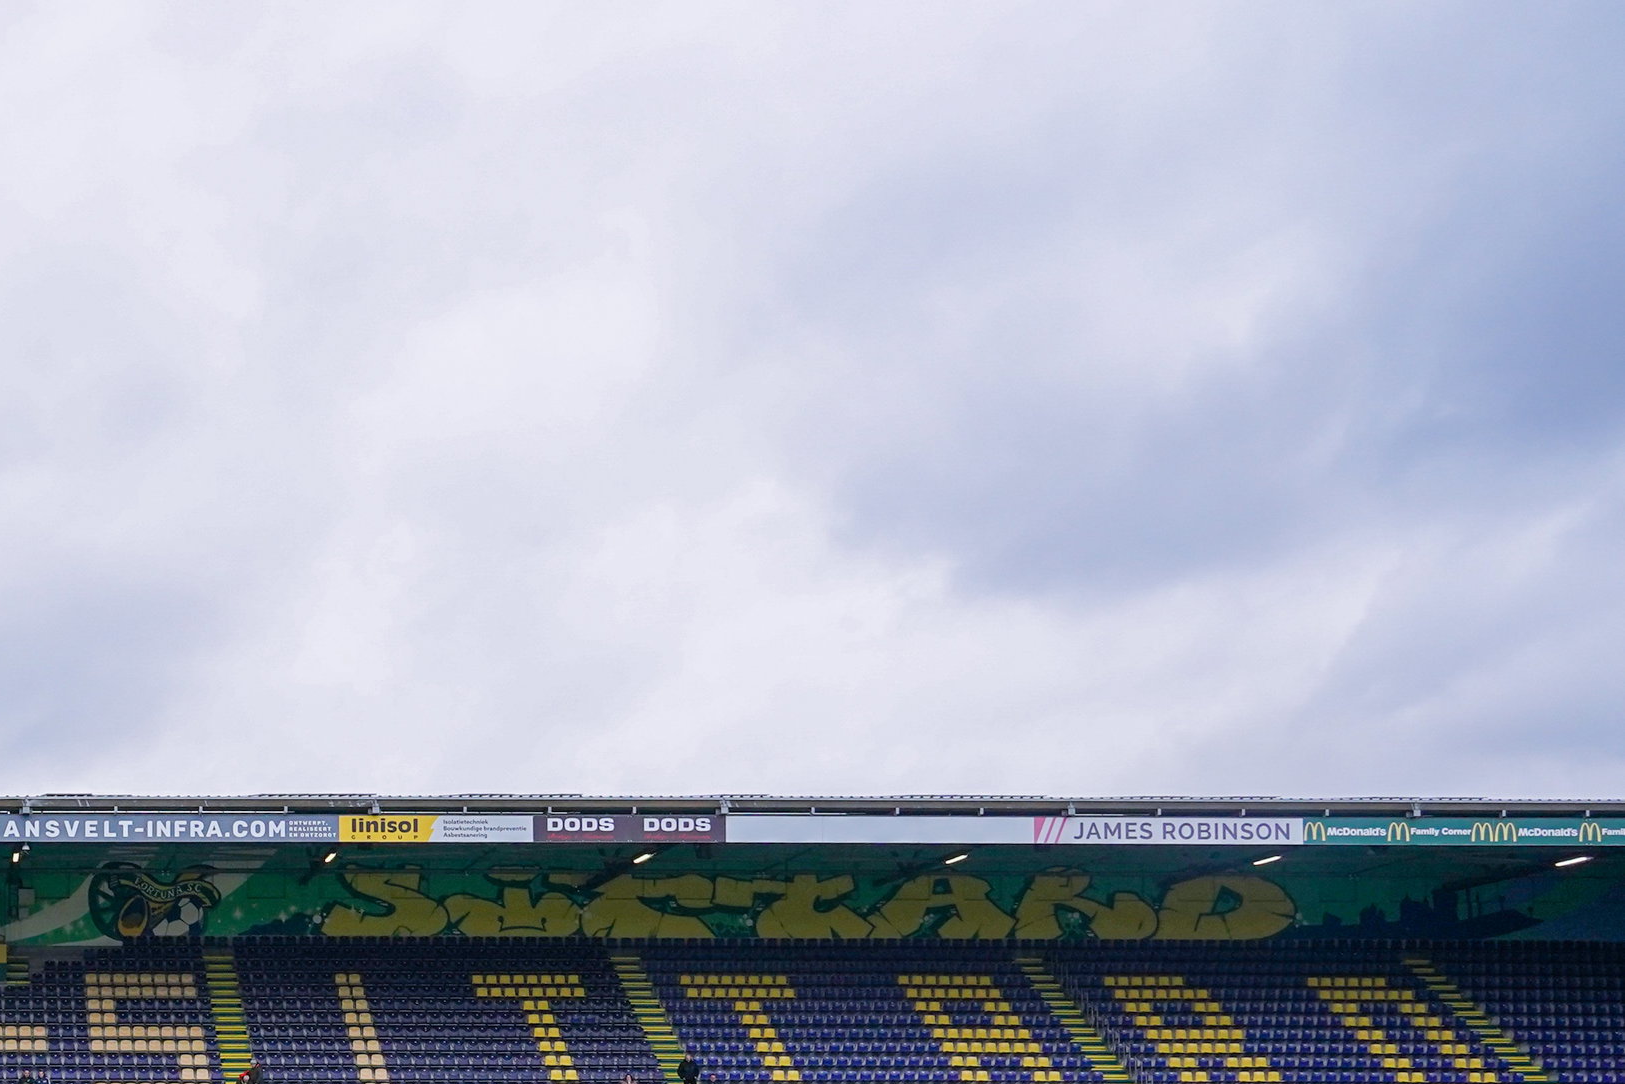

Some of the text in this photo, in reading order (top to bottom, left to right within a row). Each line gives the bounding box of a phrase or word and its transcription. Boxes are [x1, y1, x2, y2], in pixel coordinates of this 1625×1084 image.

[351, 818, 418, 833] linisol
[547, 818, 615, 832] DODS
[643, 818, 711, 832] DODS
[1074, 822, 1290, 841] JAMES ROBINSON
[1327, 827, 1387, 836] McDonald's
[1410, 827, 1471, 837] Family Corner
[1518, 827, 1578, 836] McDonald's
